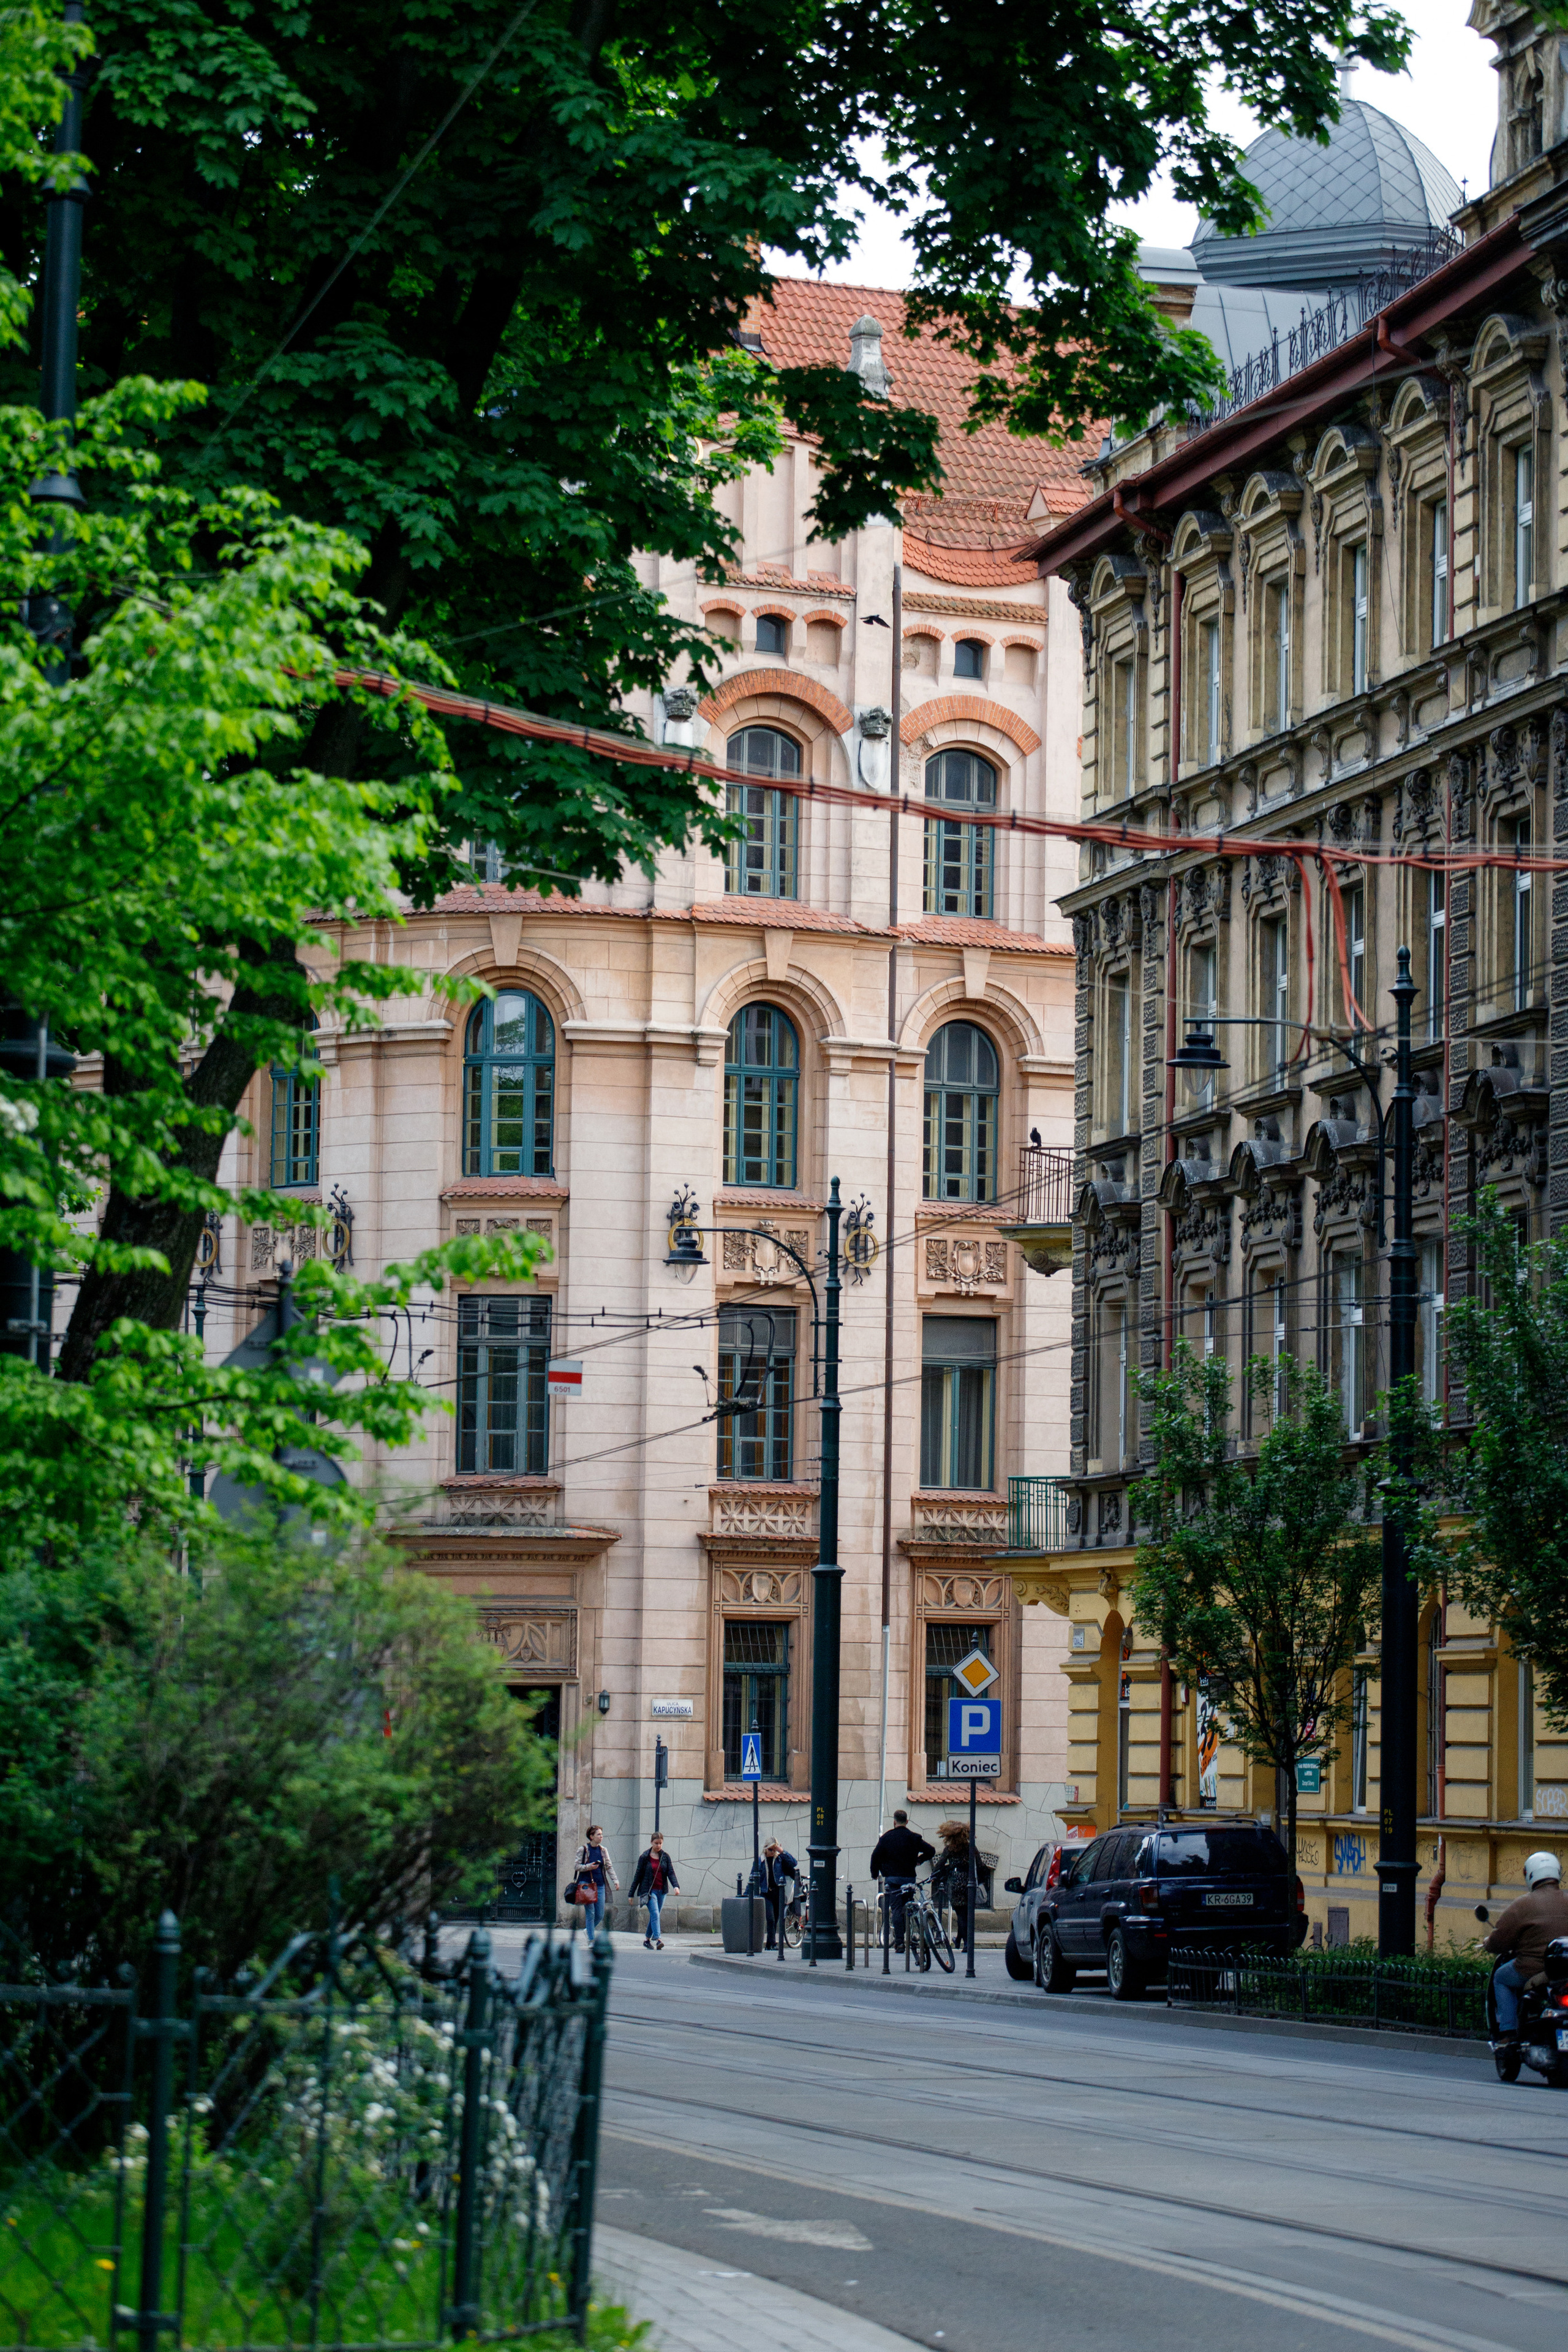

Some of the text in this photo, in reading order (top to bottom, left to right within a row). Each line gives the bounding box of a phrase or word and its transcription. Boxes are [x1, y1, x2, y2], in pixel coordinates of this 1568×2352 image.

[962, 1705, 990, 1746] P
[952, 1760, 997, 1773] Koniec
[1207, 1894, 1252, 1904] KR 6GA39
